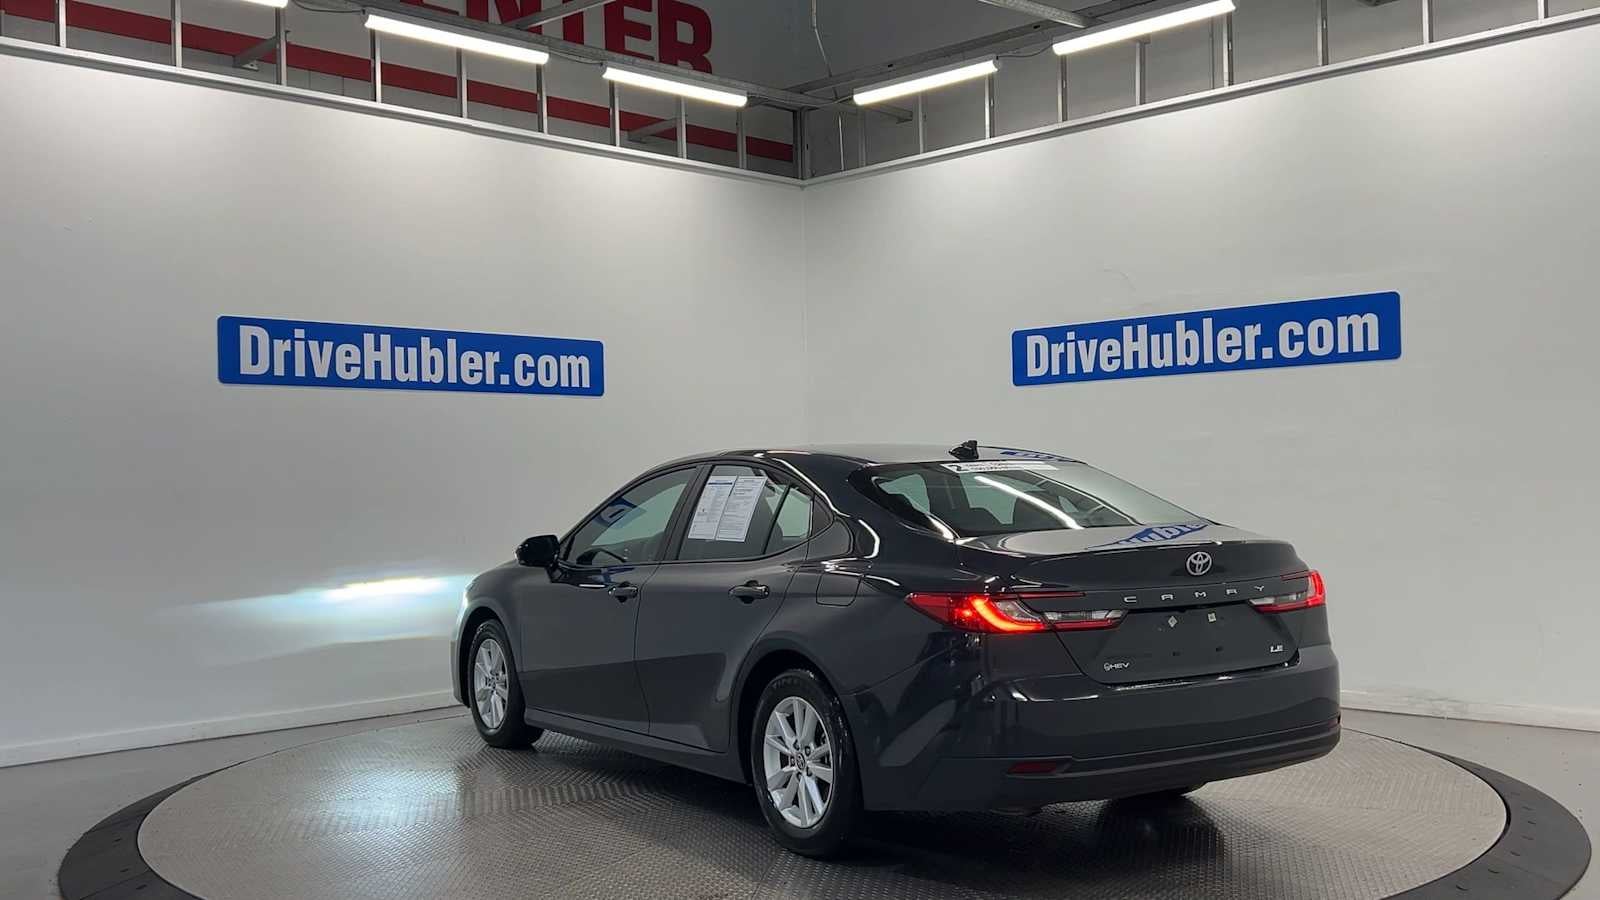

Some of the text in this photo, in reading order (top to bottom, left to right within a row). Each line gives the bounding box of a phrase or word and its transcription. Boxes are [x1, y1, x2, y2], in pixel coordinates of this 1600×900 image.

[239, 324, 592, 389] DriveHubler.com
[1026, 310, 1380, 377] DriveHubler.com
[1123, 584, 1266, 603] CAMRY
